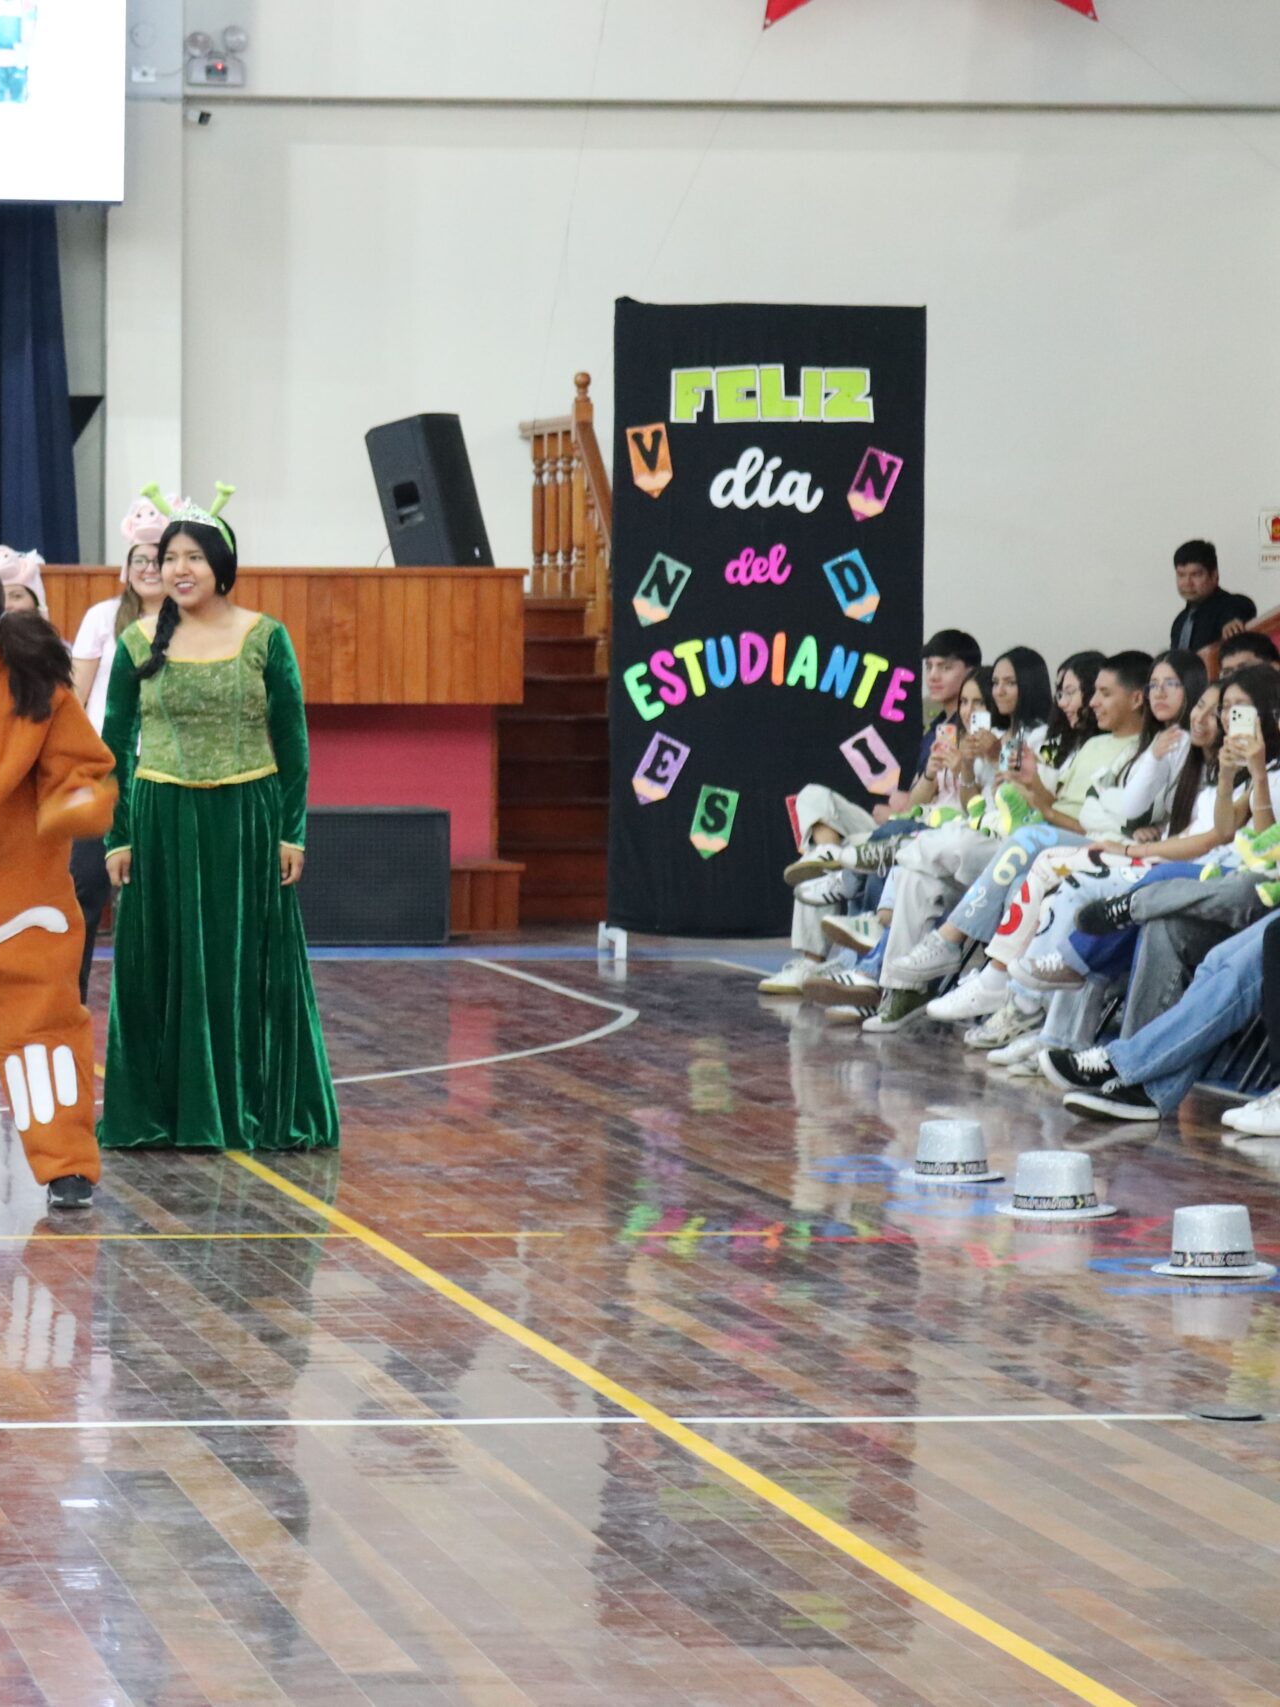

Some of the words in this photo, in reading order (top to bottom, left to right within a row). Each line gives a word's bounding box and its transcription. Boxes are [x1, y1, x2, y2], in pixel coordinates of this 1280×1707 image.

[671, 364, 874, 424] FELIZ
[632, 429, 663, 472] V
[709, 446, 824, 513] día
[855, 453, 897, 501] N
[641, 560, 685, 607] N
[724, 543, 792, 586] del
[832, 560, 867, 602] D
[623, 632, 916, 722] ESTUDIANTE
[643, 740, 681, 784] E
[700, 794, 730, 833] S
